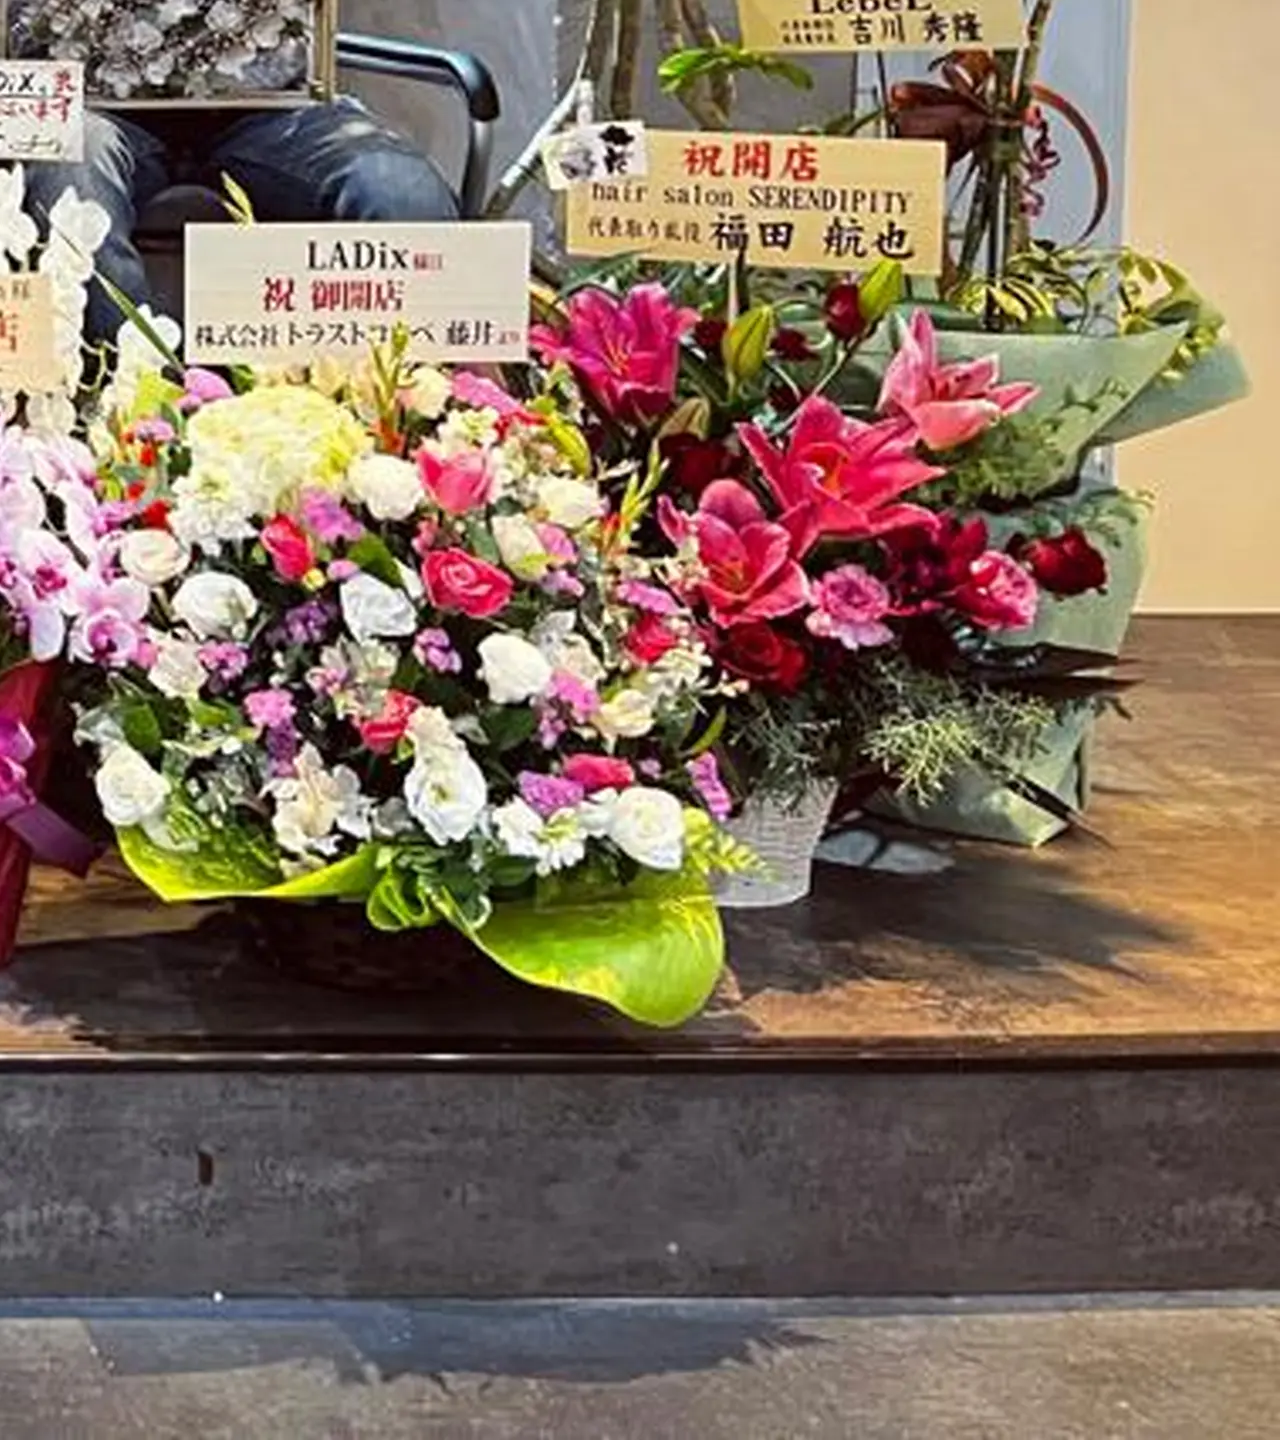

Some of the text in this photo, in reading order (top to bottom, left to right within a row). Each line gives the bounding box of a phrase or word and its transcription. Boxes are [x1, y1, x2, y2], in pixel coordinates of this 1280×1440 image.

[849, 13, 906, 45] 吉川
[684, 140, 820, 183] 祝開店
[592, 181, 914, 215] hair salon SERENDIPITY
[263, 277, 406, 312] 祝 御開店
[195, 321, 278, 348] 株式会社
[287, 320, 435, 348] トラストコベ
